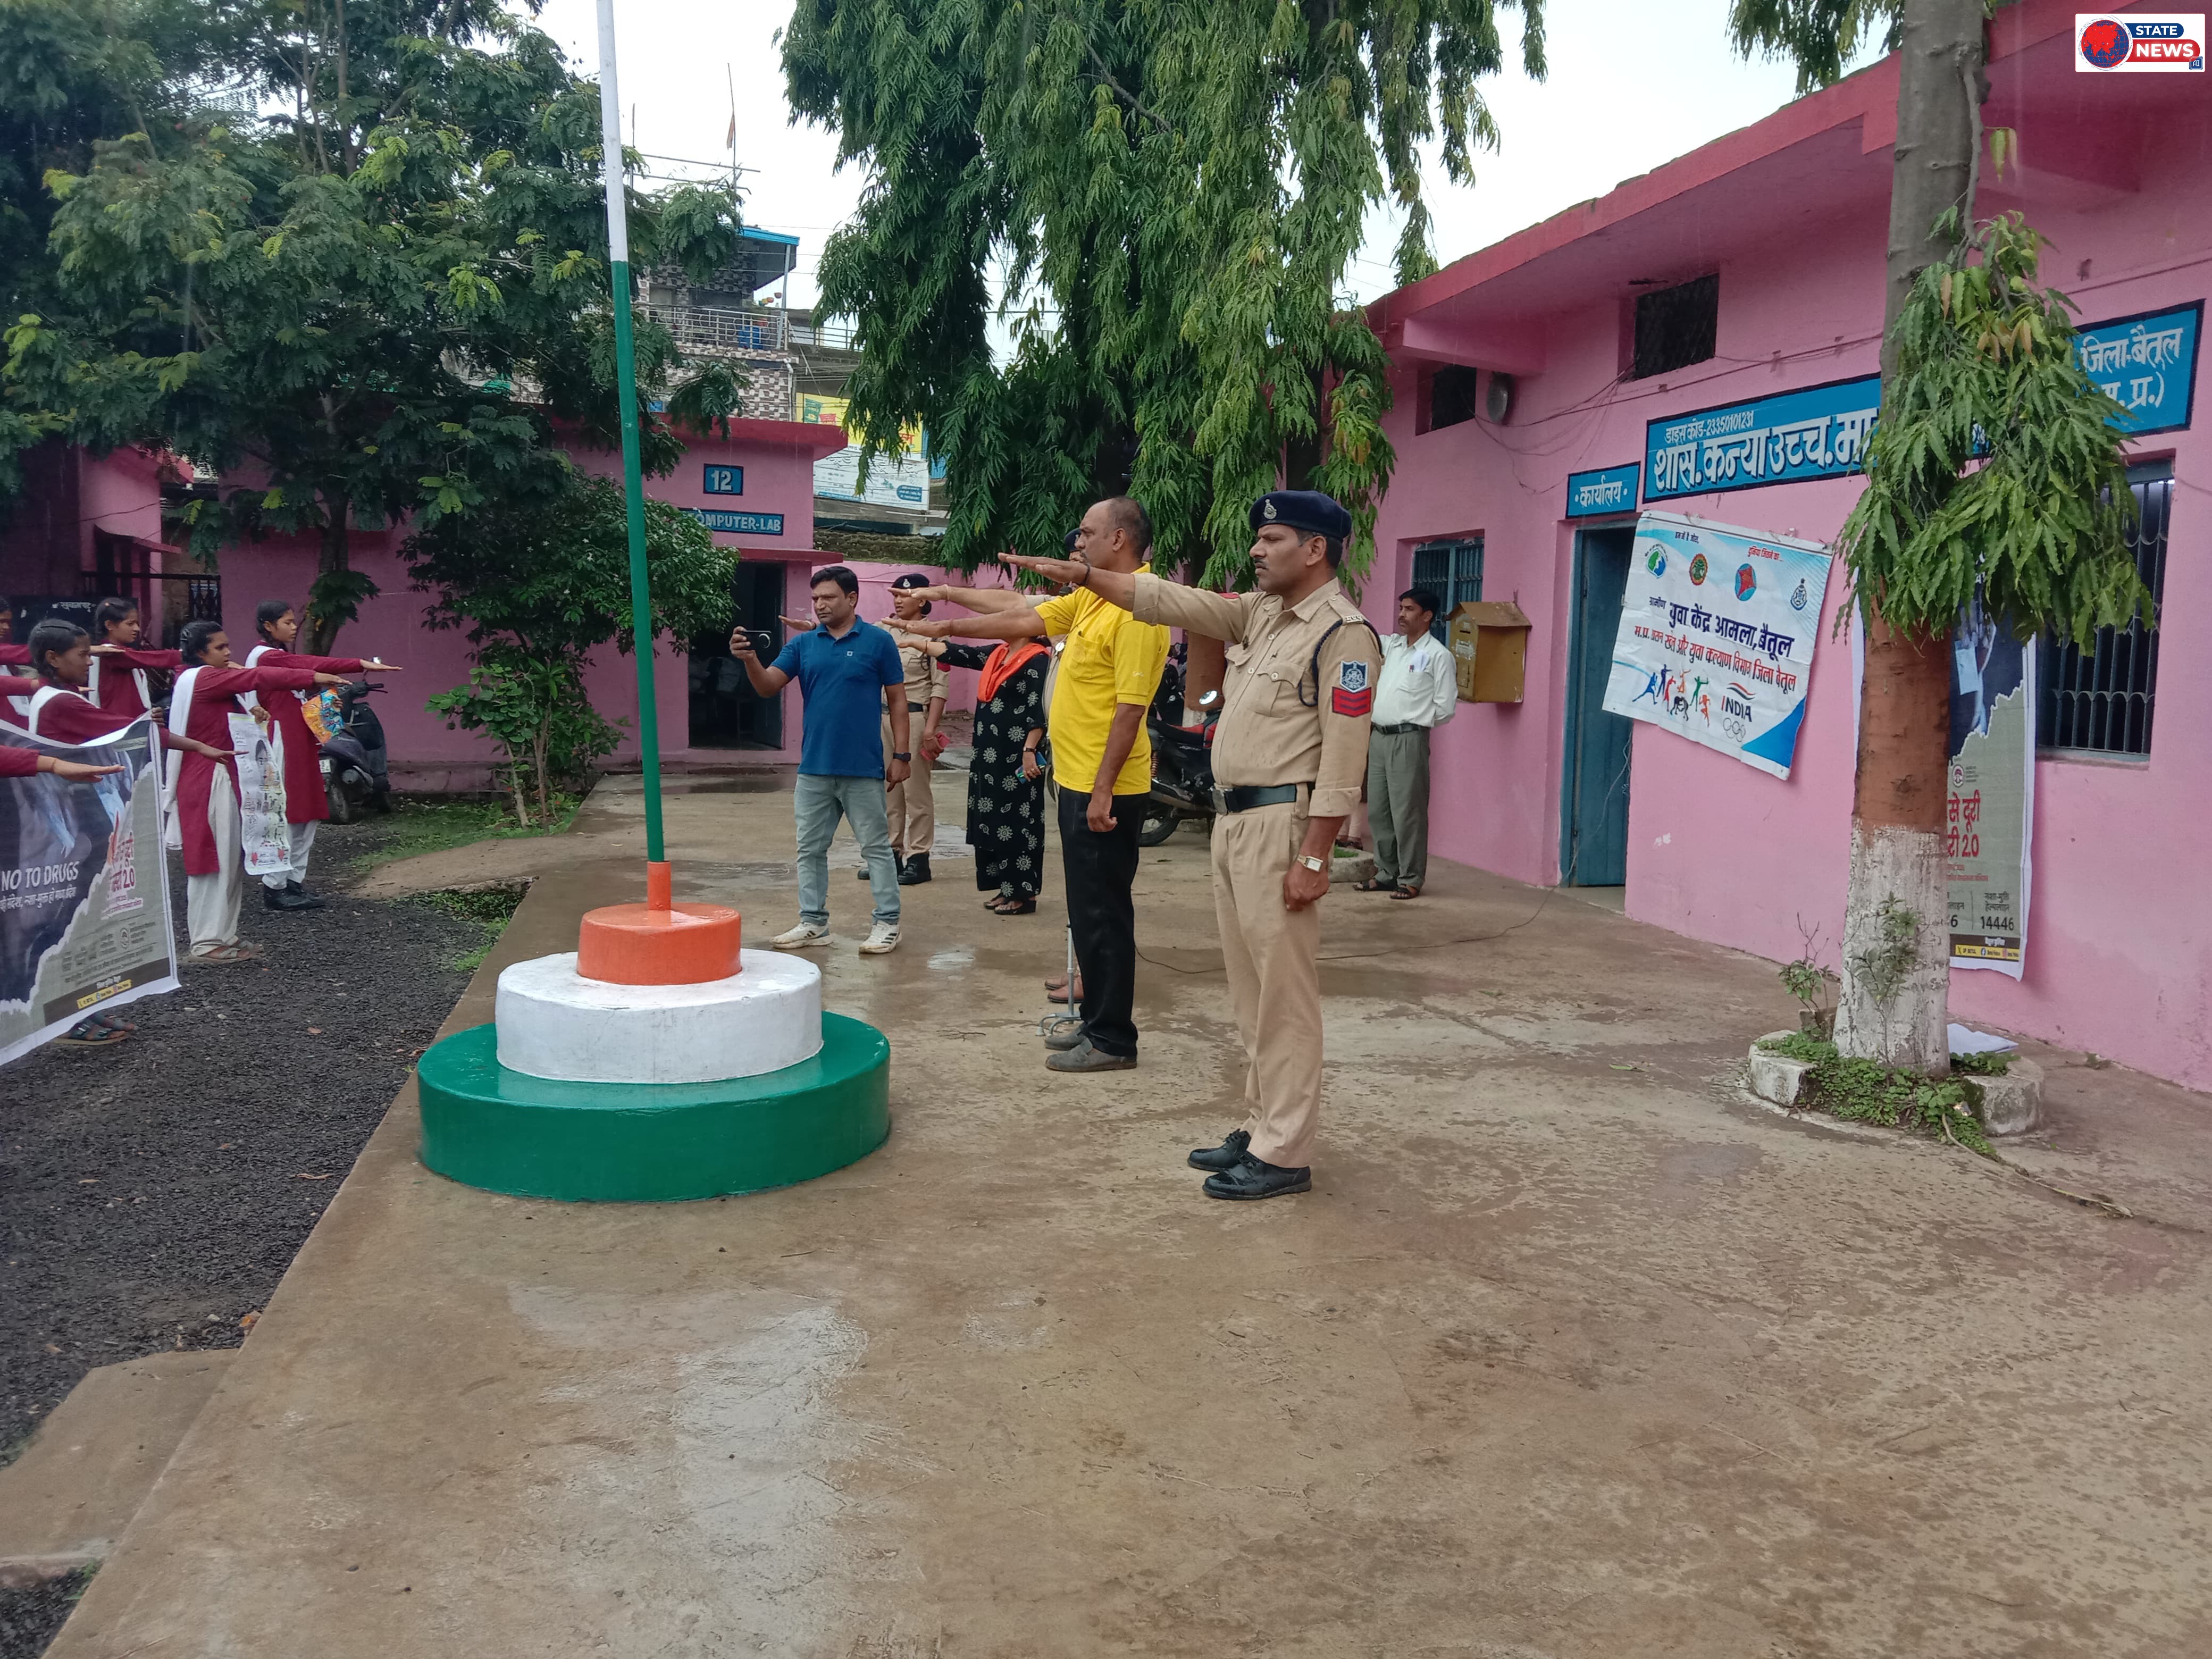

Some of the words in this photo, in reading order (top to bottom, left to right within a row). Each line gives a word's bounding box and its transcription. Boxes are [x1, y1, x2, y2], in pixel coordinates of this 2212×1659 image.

[711, 470, 732, 490] 12
[1579, 474, 1623, 507] कार्यालय
[1669, 602, 1689, 628] युवा
[1690, 603, 1712, 633] केंद्र
[1689, 642, 1705, 664] युवा
[1705, 647, 1732, 670] कल्याण
[1752, 658, 1775, 685] जिला
[1721, 696, 1752, 722] INDIA
[1, 869, 22, 891] NO
[26, 867, 40, 889] TO
[43, 860, 80, 885] DRUGS
[1981, 916, 2014, 931] 14446
